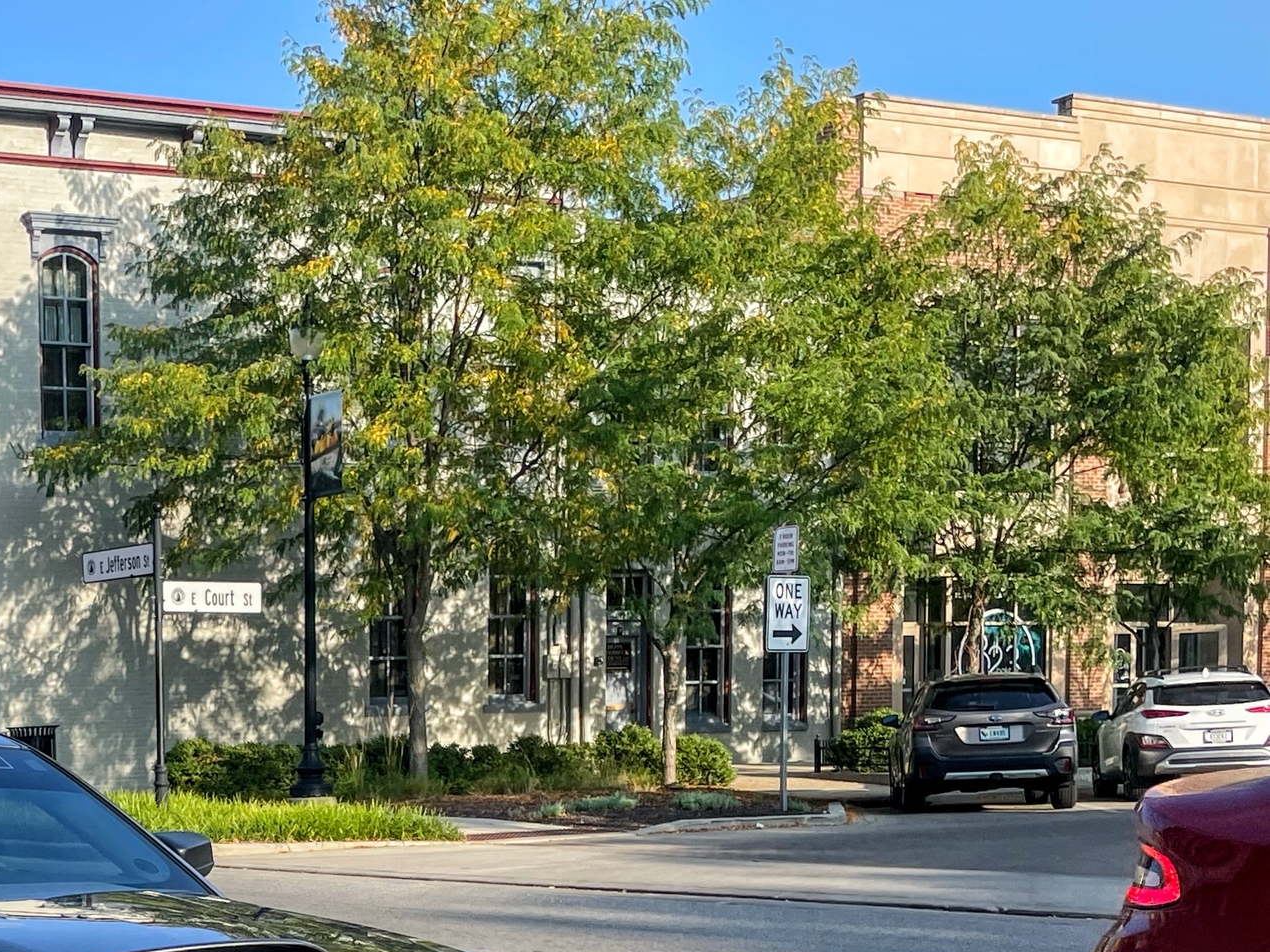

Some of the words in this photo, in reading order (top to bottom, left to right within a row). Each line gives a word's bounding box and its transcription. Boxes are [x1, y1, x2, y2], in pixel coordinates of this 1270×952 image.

[100, 562, 104, 574] E
[106, 555, 141, 574] Jefferson
[143, 555, 150, 568] St
[191, 593, 196, 605] E
[205, 589, 234, 606] Court
[243, 593, 253, 606] St
[776, 583, 802, 599] ONE
[775, 603, 803, 619] WAY
